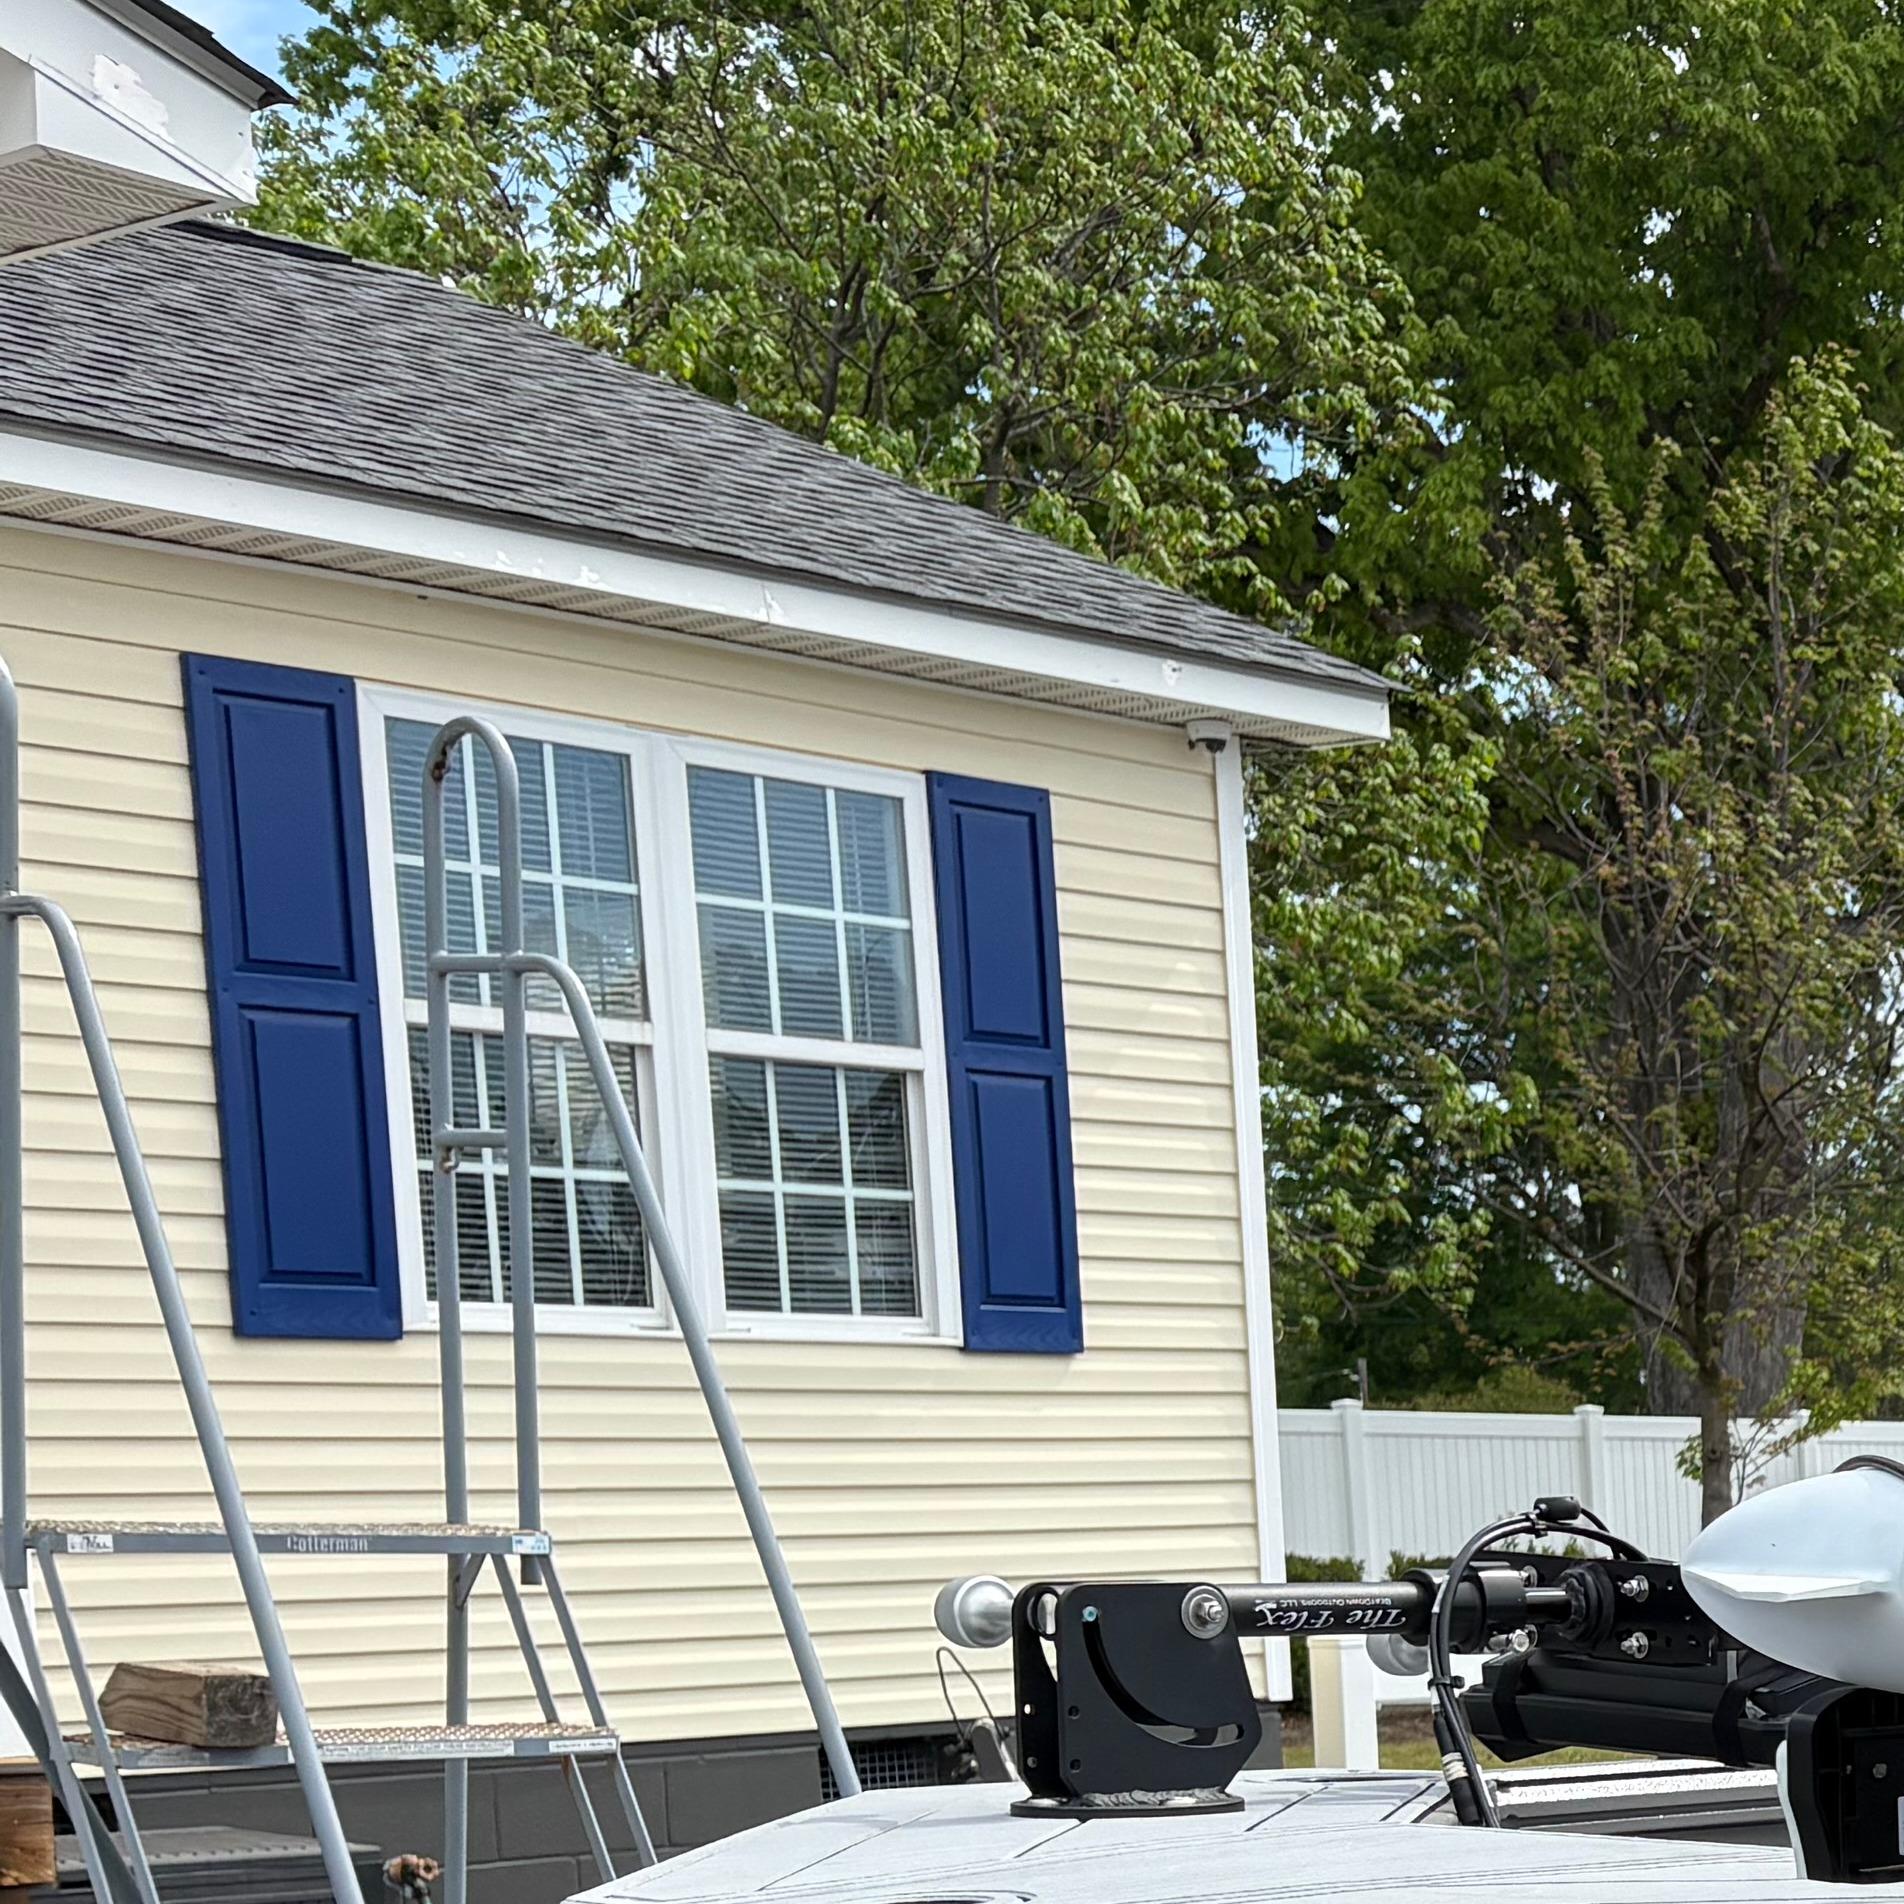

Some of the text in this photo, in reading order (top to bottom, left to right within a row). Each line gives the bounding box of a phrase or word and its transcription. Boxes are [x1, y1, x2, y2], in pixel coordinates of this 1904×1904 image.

[287, 1536, 368, 1552] Cotterman
[1255, 1603, 1406, 1632] The Flex
